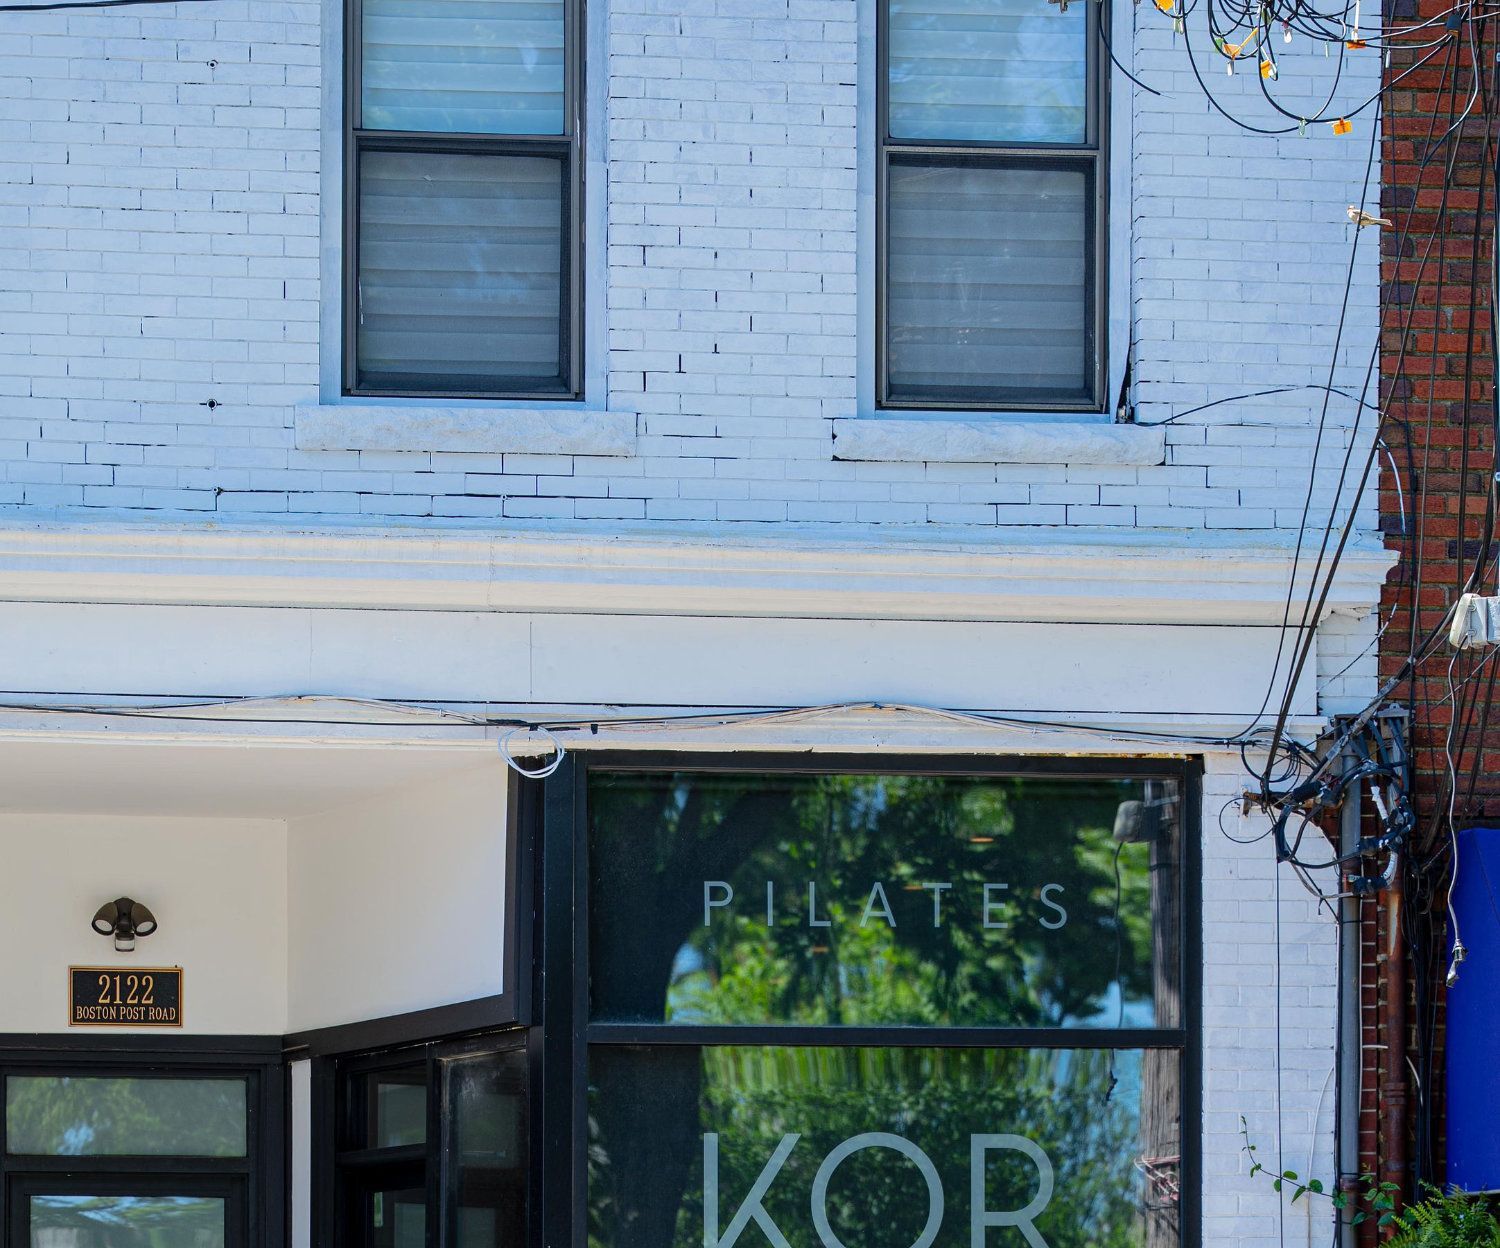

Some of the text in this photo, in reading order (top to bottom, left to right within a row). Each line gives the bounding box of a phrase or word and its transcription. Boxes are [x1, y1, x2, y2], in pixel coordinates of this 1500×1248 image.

[703, 881, 1069, 930] PILATES
[98, 974, 154, 1004] 2122
[76, 1006, 176, 1021] BOSTON POST ROAD
